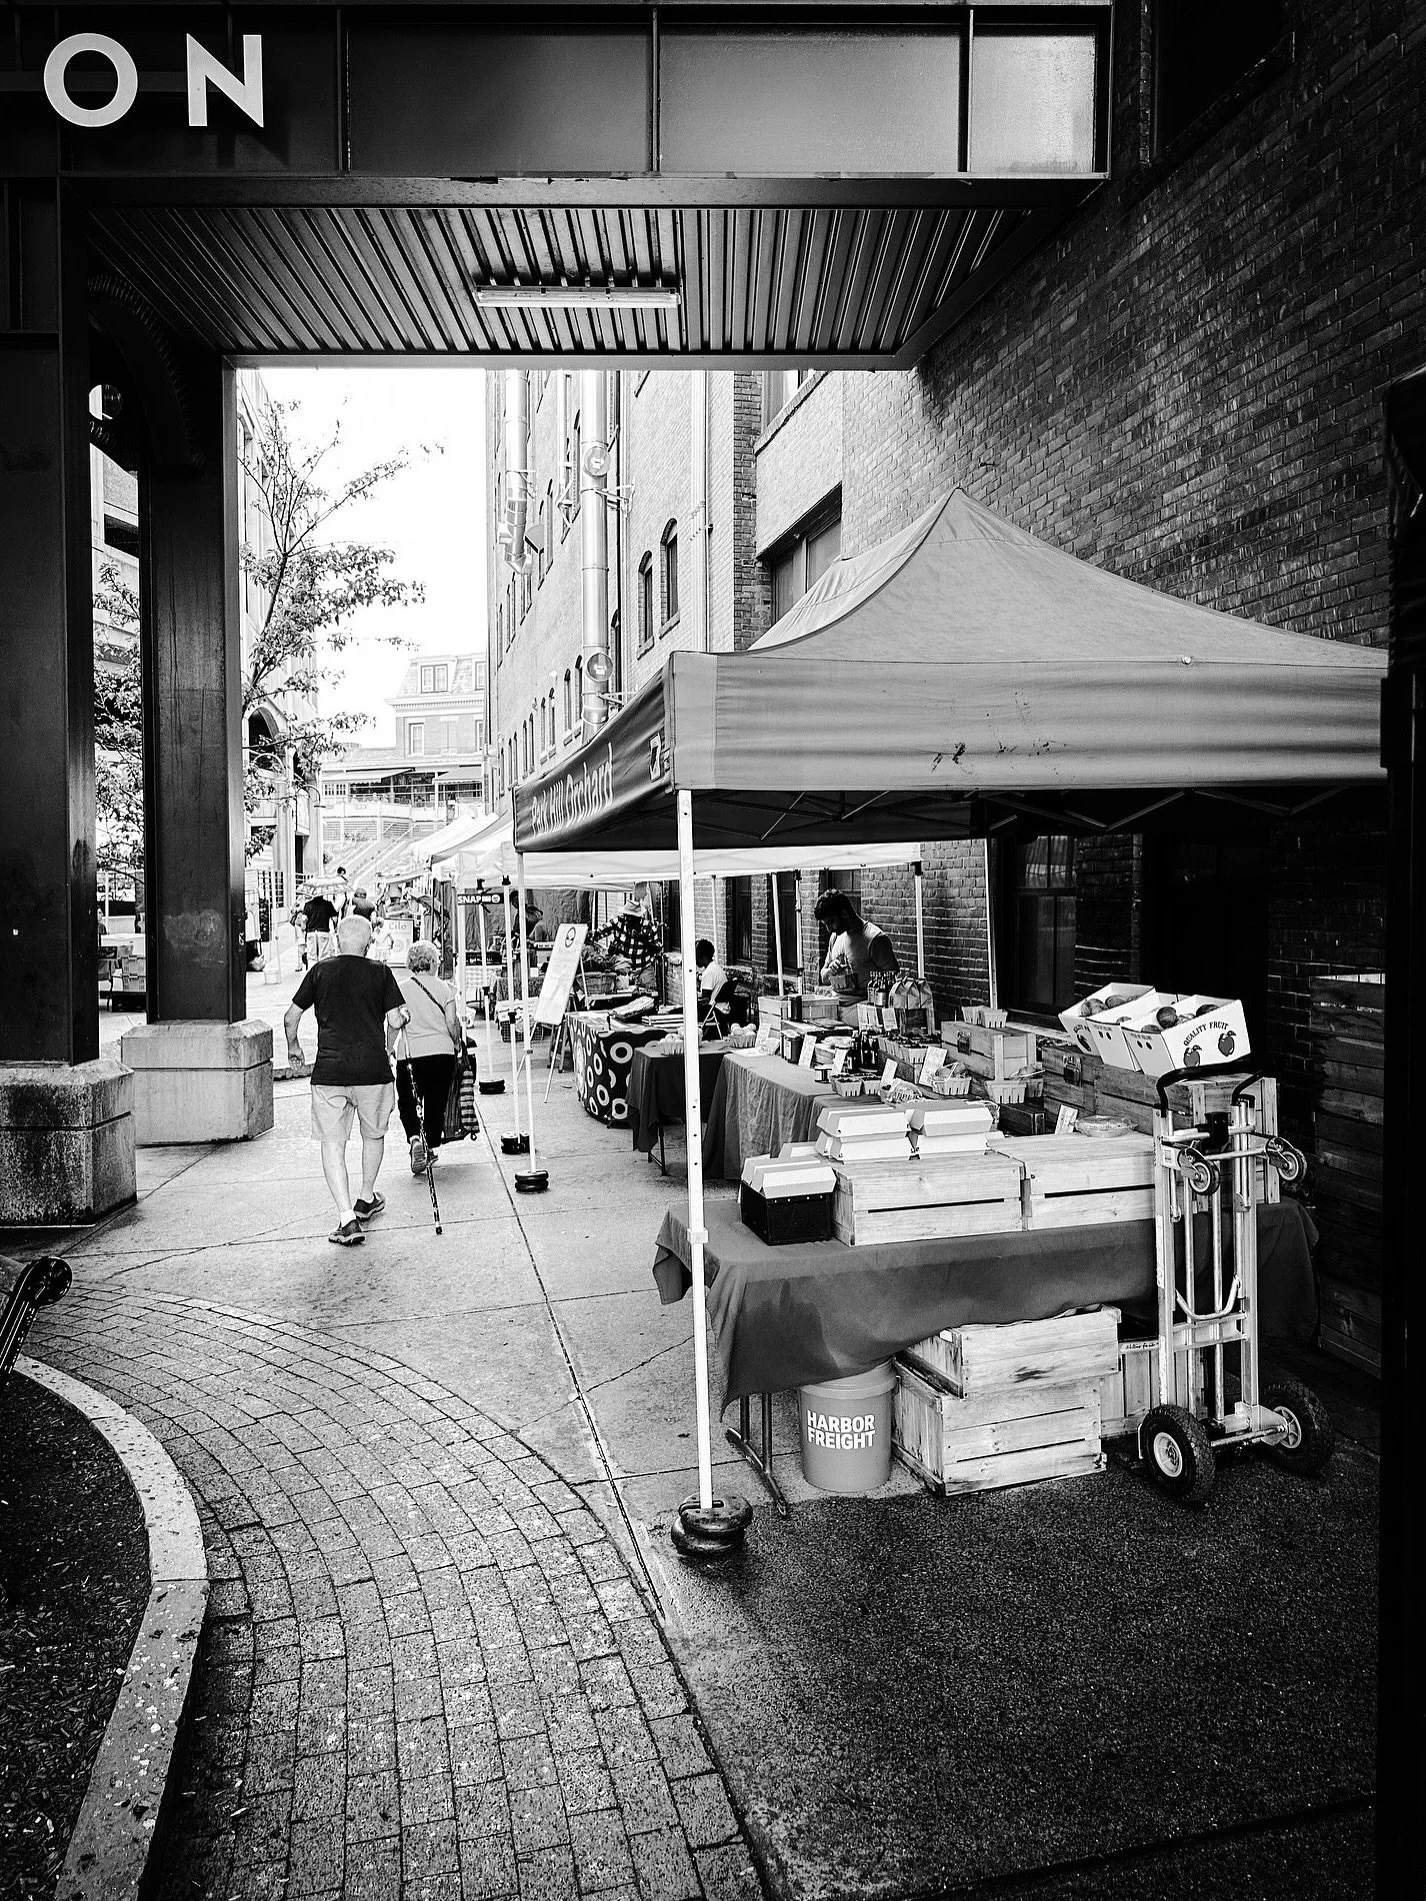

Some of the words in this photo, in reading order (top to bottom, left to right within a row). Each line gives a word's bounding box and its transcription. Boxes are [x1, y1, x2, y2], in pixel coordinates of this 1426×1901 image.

[43, 32, 264, 128] ON
[550, 779, 564, 832] Hill
[566, 742, 613, 829] Orchard
[457, 895, 481, 904] SNAP
[1183, 1023, 1207, 1046] QUALITY
[1209, 1021, 1229, 1031] FRUIT
[807, 1409, 875, 1433] HARBOR
[807, 1426, 876, 1450] FREIGHT
